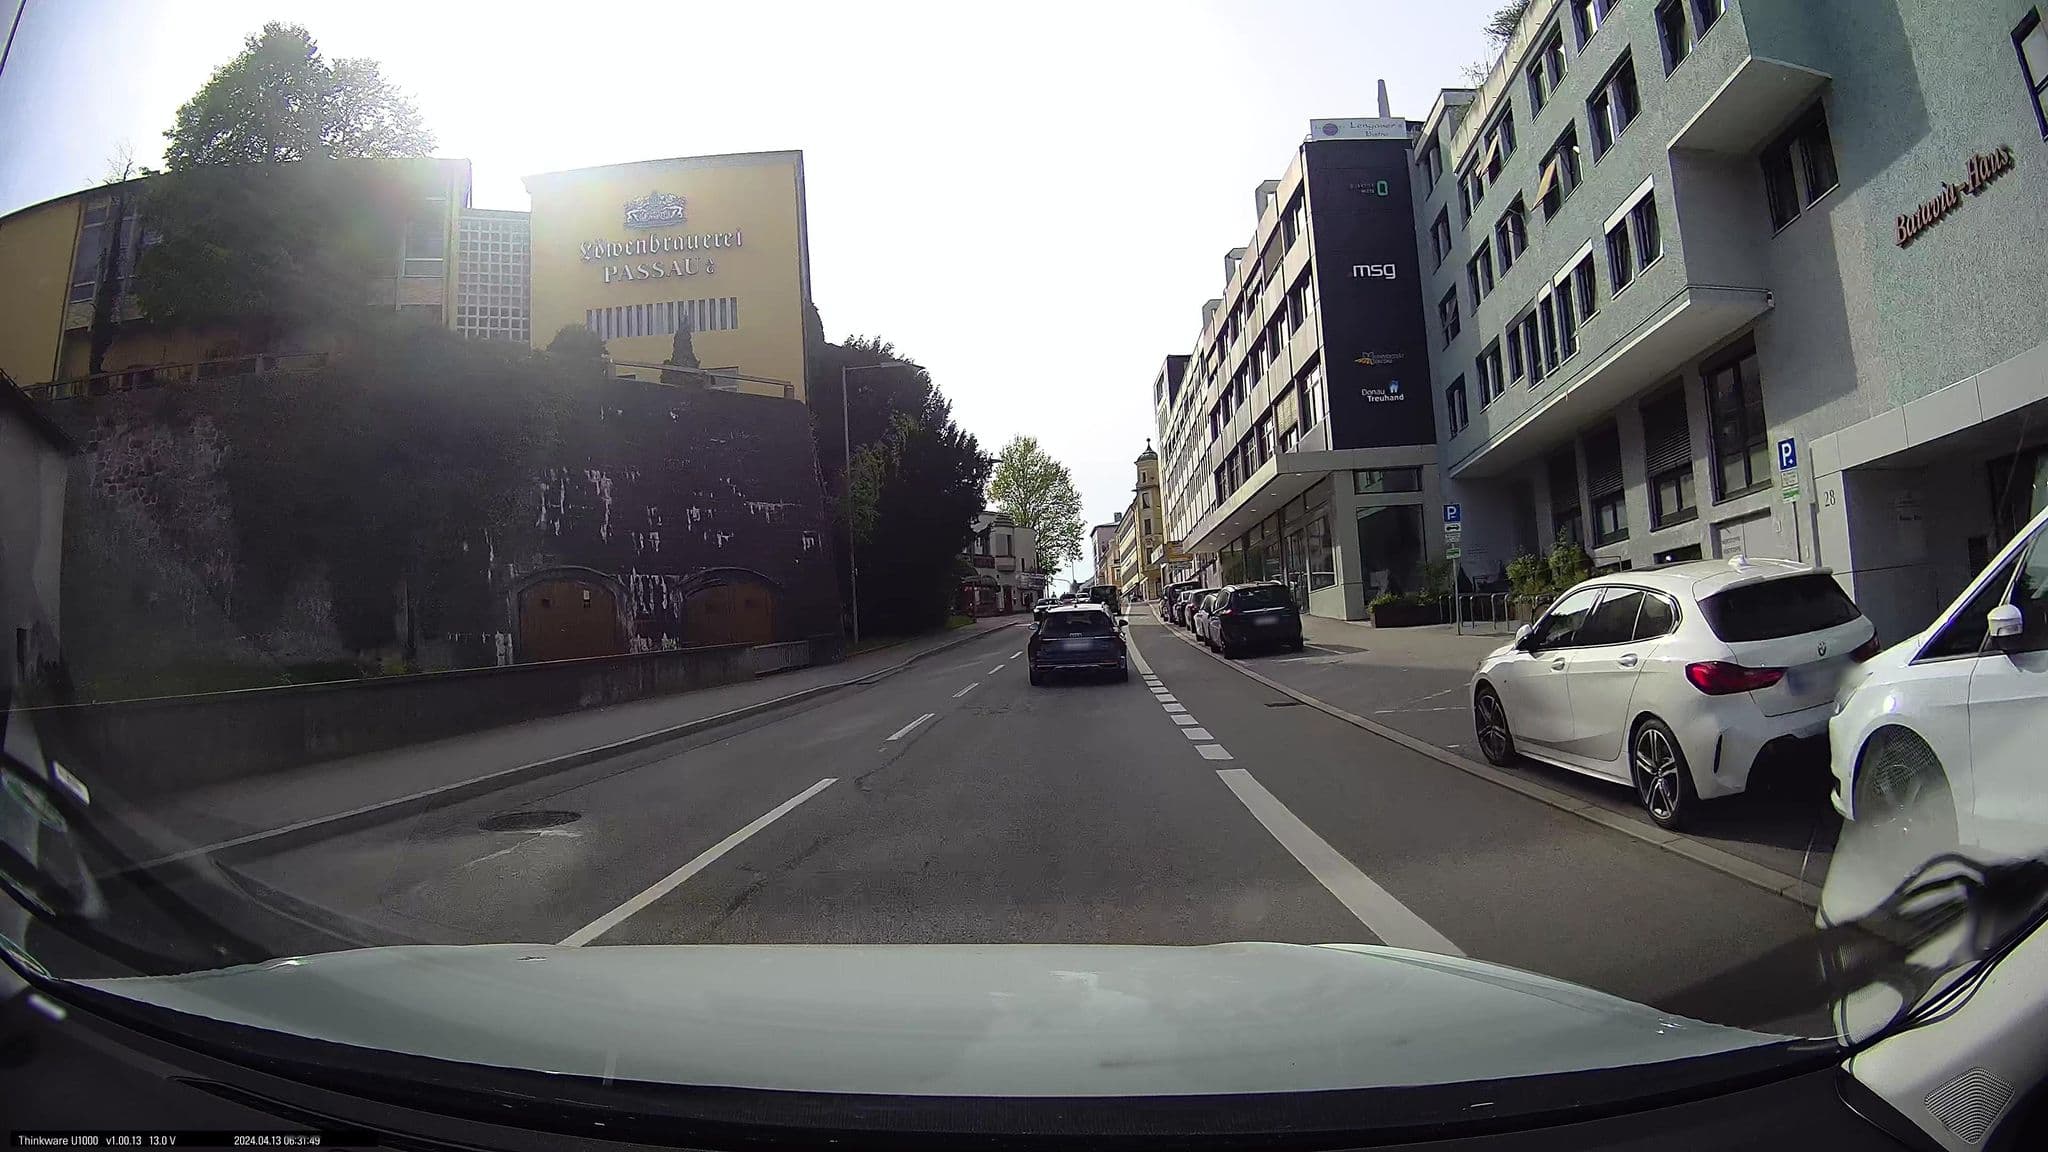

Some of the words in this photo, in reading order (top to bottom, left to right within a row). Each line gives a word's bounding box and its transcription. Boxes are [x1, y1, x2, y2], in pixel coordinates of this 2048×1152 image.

[579, 229, 743, 260] Löwenbrauerei
[603, 258, 701, 284] PASSAU
[1353, 264, 1396, 280] msg
[1361, 388, 1385, 396] Donau
[1367, 393, 1404, 403] Treuhand
[1781, 443, 1792, 467] P
[1824, 489, 1836, 507] 28
[1447, 506, 1457, 520] P
